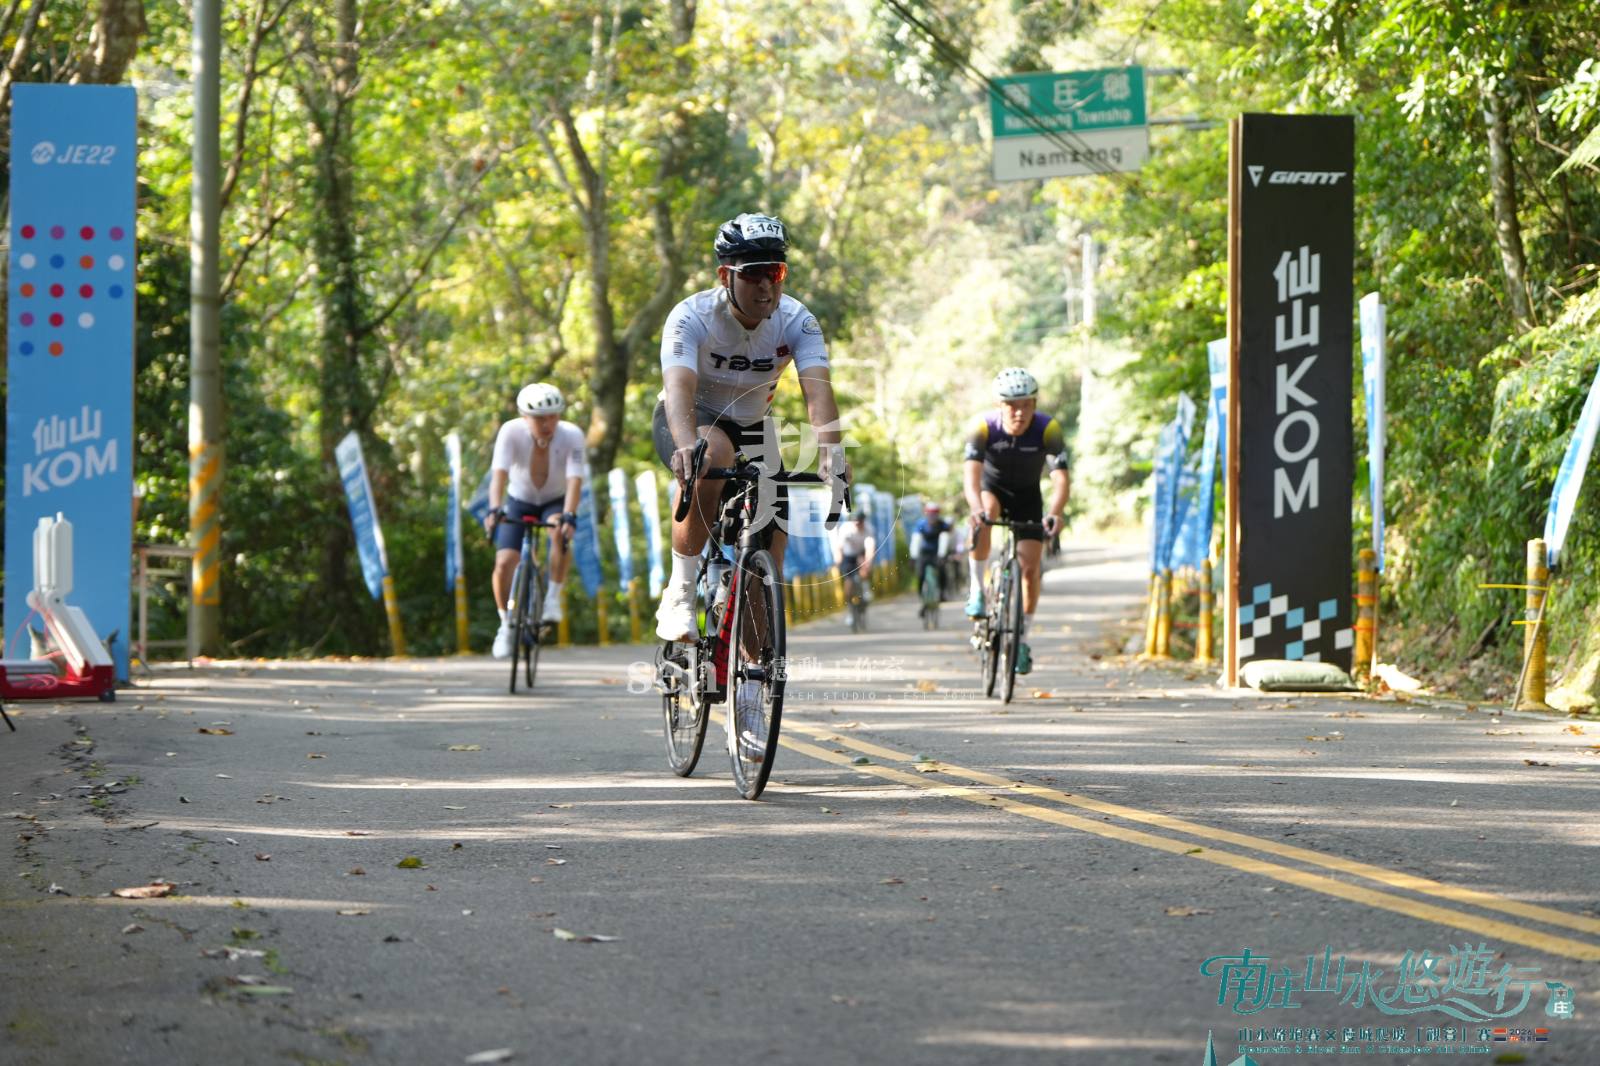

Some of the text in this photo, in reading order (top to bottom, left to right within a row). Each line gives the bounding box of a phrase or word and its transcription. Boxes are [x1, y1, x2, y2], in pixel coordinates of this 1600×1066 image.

[57, 144, 116, 165] JE22
[1268, 171, 1346, 185] GIANT
[32, 404, 102, 456] 仙山
[22, 438, 118, 497] KOM
